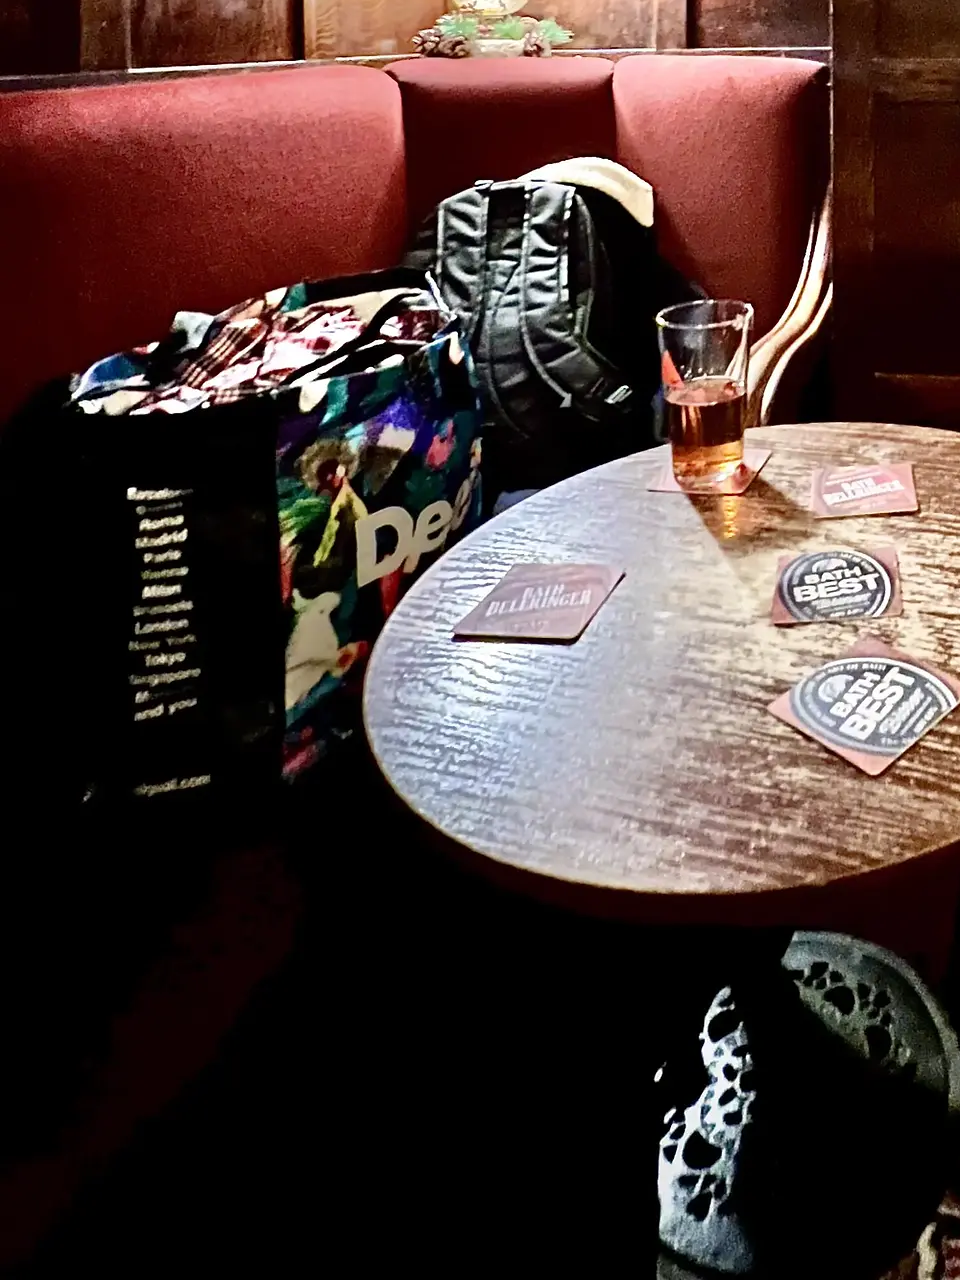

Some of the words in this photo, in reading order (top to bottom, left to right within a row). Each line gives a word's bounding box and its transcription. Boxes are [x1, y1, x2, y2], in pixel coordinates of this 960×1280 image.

[135, 528, 188, 549] Madrid
[804, 565, 862, 585] BATH
[142, 584, 182, 600] Milan
[793, 573, 880, 602] BEST
[135, 619, 189, 635] London
[830, 671, 881, 718] BATH
[839, 666, 915, 741] BEST
